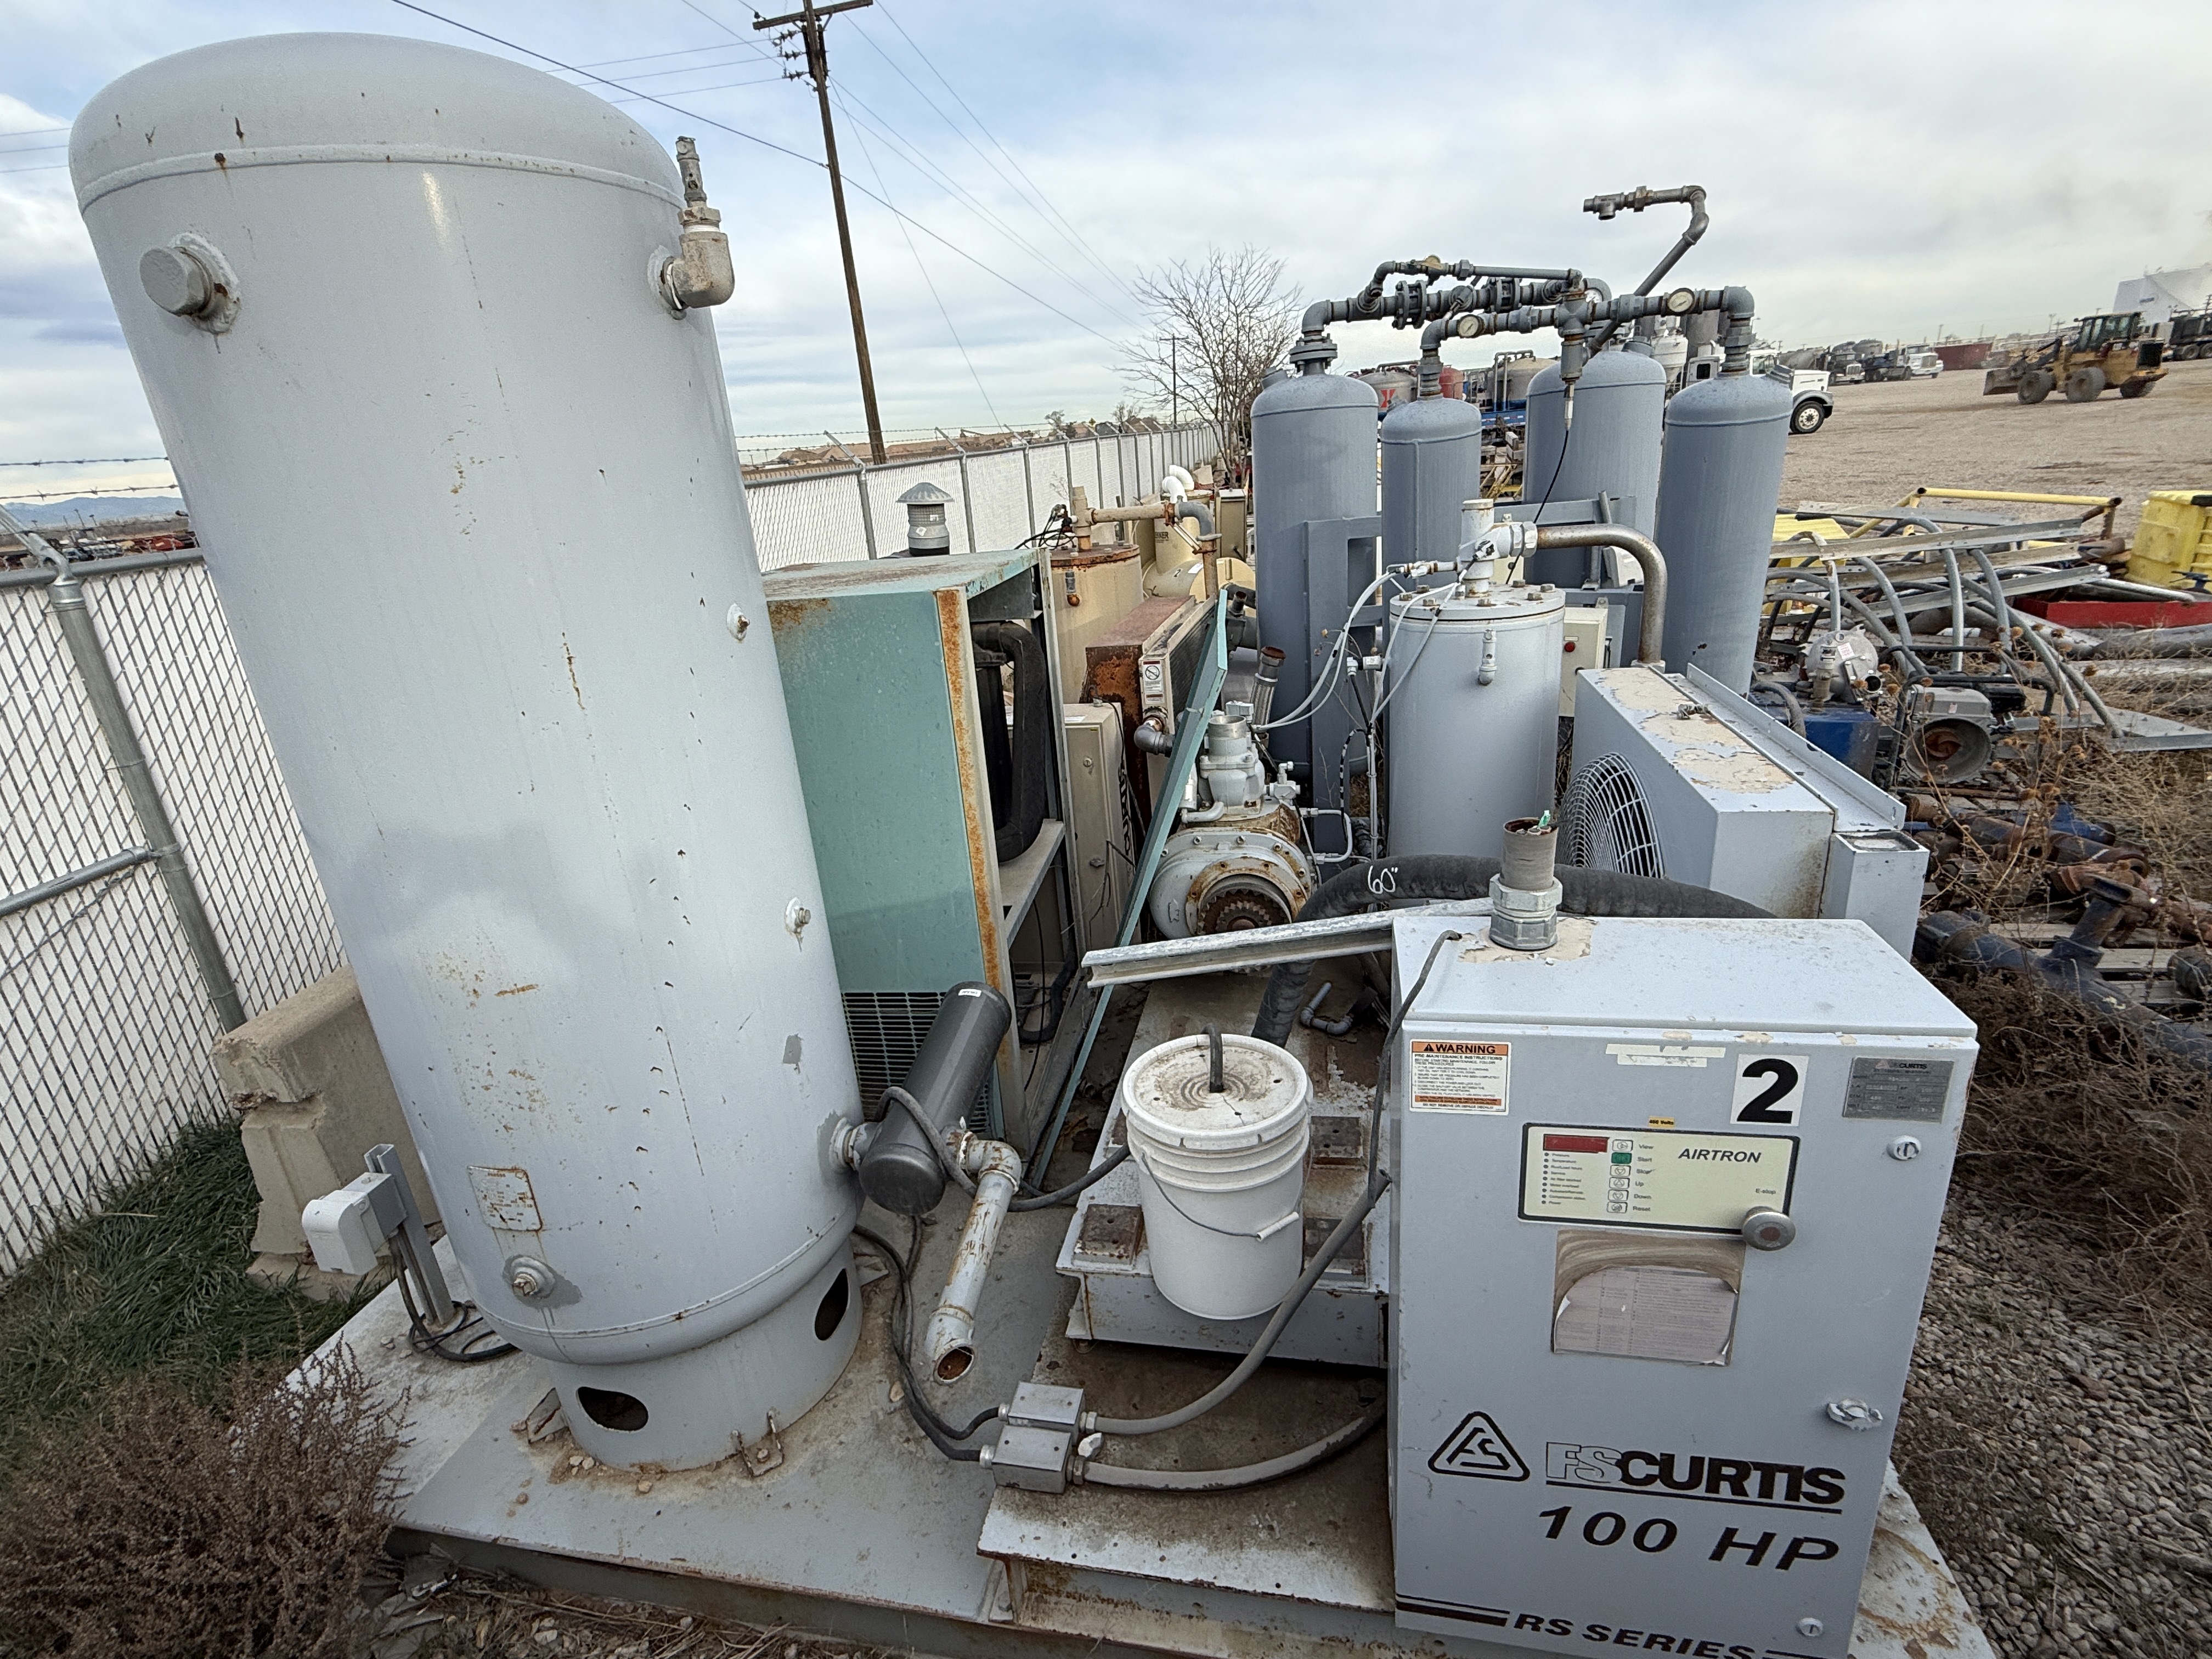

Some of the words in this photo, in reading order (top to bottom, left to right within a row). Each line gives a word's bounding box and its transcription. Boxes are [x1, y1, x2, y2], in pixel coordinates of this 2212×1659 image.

[1367, 865, 1398, 894] 60"
[1435, 1043, 1496, 1054] WARNING
[1736, 1058, 1799, 1124] 2
[1678, 1148, 1762, 1163] AIRTRON
[1539, 1505, 1678, 1553] 100
[1708, 1526, 1839, 1571] HP
[1513, 1612, 1574, 1636] RS
[1582, 1623, 1756, 1659] SERIES
